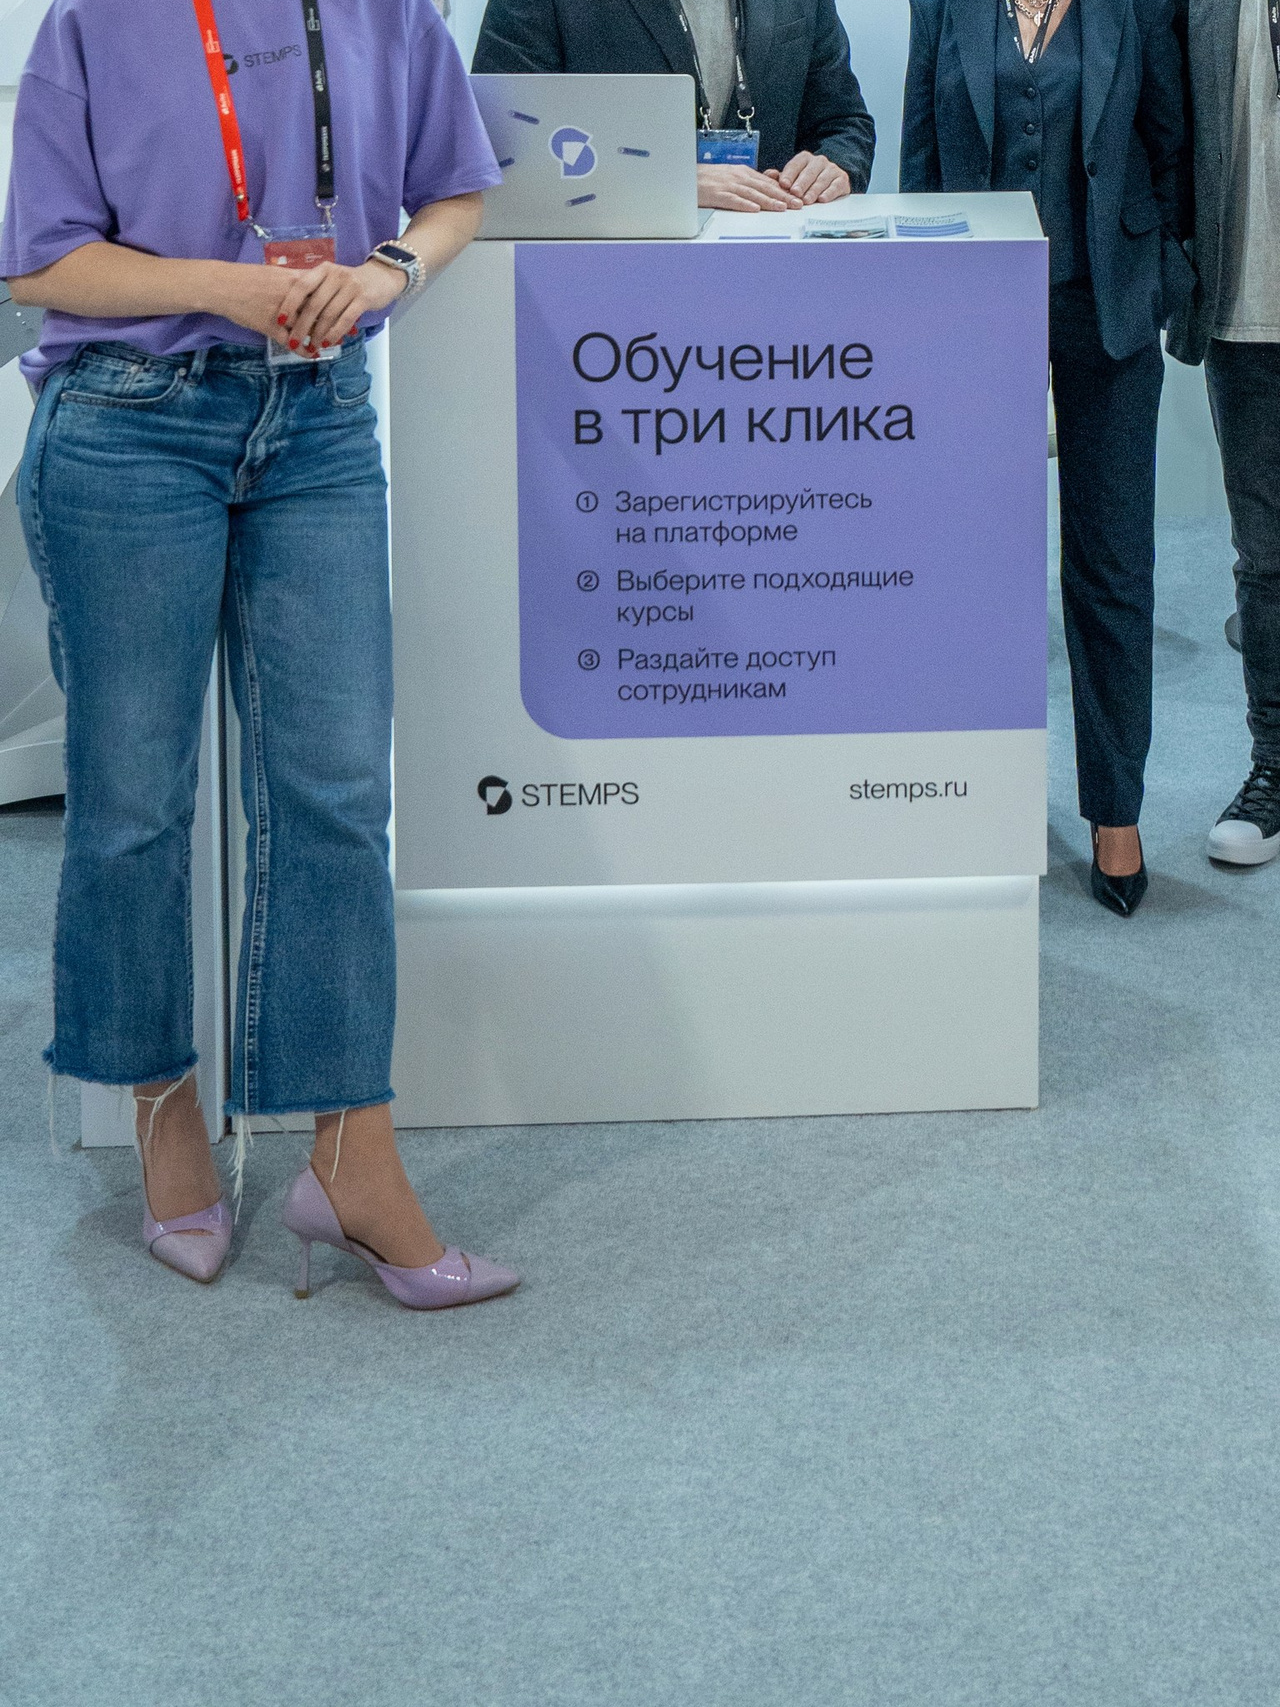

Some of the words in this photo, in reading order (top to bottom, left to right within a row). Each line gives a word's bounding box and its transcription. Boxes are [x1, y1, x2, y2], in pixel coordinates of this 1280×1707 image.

[244, 44, 303, 68] STEMPS
[572, 332, 874, 392] Обучение
[575, 410, 603, 444] в
[622, 405, 726, 454] три
[747, 403, 916, 444] клика
[616, 486, 872, 516] Зарегистрируйтесь
[616, 525, 646, 544] на
[653, 520, 798, 547] платформе
[617, 569, 745, 595] Выберите
[753, 568, 914, 592] подходящие
[617, 603, 694, 625] курсы
[618, 647, 738, 673] Раздайте
[746, 649, 836, 672] доступ
[618, 681, 786, 705] сотрудникам
[521, 782, 639, 807] STEMPS
[849, 777, 967, 803] stemps.ru
